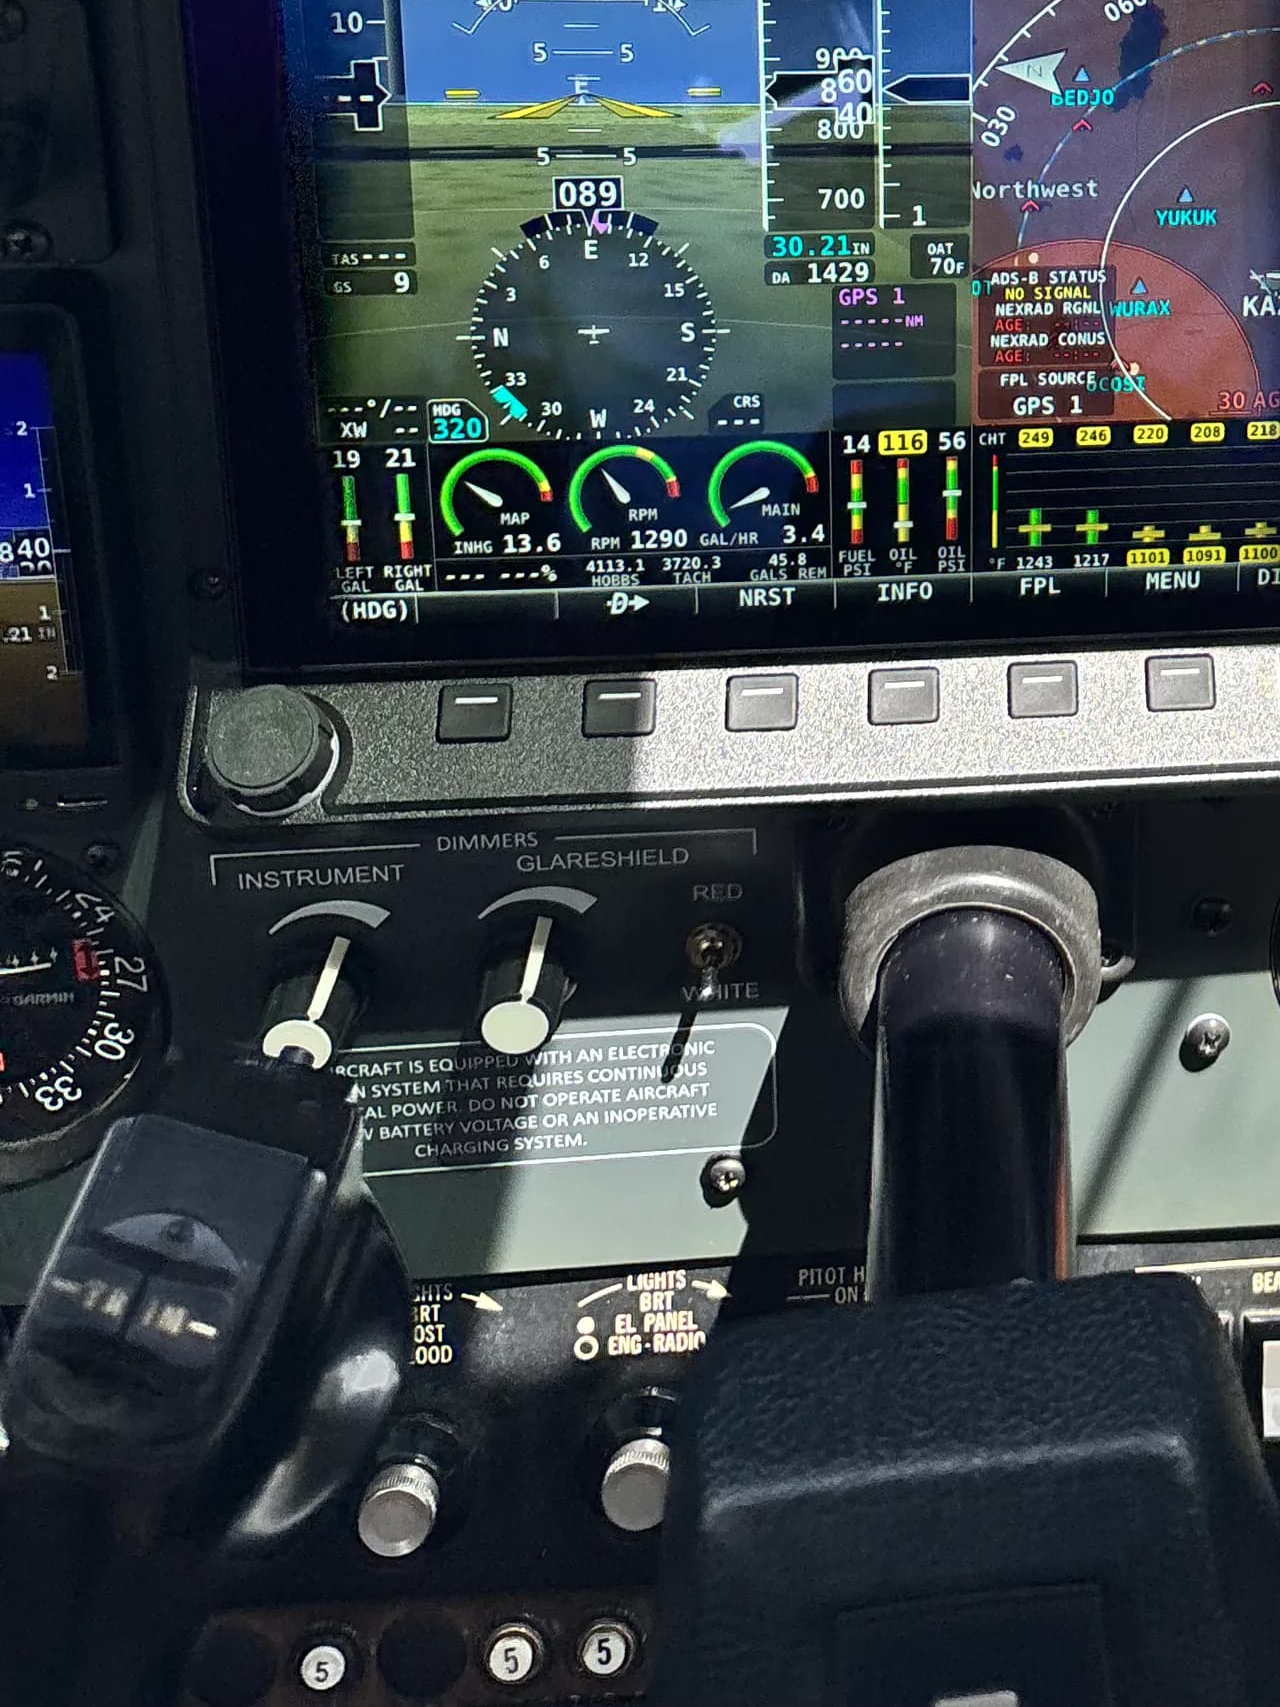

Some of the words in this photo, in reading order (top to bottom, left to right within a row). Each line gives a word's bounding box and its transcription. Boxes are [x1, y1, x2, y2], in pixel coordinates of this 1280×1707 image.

[331, 12, 364, 35] 10
[559, 182, 618, 207] 089
[818, 189, 865, 209] 700
[1156, 209, 1217, 225] YUKUK
[772, 235, 850, 257] 30.21
[927, 242, 953, 255] OAT
[772, 271, 790, 284] DA
[807, 262, 870, 283] 1429
[991, 271, 1039, 285] ADS-B
[1049, 269, 1106, 284] STATUS
[839, 289, 878, 306] GPS
[1005, 288, 1024, 301] NO
[1034, 286, 1091, 300] SIGNAL
[995, 302, 1054, 316] NEXRAD
[1063, 301, 1101, 315] RGNL
[990, 333, 1049, 347] NEXRAD
[1058, 332, 1106, 346] CONUS
[1000, 373, 1028, 386] FPL
[433, 404, 461, 417] HDG
[733, 395, 760, 408] CRS
[1013, 395, 1055, 414] GPS
[432, 419, 482, 439] 320
[979, 432, 1006, 445] CHT
[1022, 431, 1050, 445] 249
[843, 435, 871, 454] 14
[883, 434, 924, 451] 116
[938, 432, 966, 451] 56
[333, 450, 361, 469] 19
[385, 448, 416, 468] 21
[500, 512, 530, 525] MAP
[629, 508, 658, 521] RPM
[762, 503, 800, 516] MAIN
[454, 540, 493, 554] INHG
[503, 534, 561, 553] 13.6
[591, 537, 621, 550] RPM
[632, 529, 688, 549] 1290
[700, 532, 758, 546] GAL/HR
[783, 524, 825, 543] 3.4
[586, 558, 645, 573] 4113.1
[769, 553, 807, 566] 45.8
[839, 550, 876, 563] FUEL
[1016, 555, 1053, 569] 1243
[1073, 553, 1110, 567] 1217
[383, 564, 432, 578] RIGHT
[674, 571, 711, 585] TACH
[844, 563, 871, 576] PSI
[395, 579, 424, 591] GAL
[592, 573, 640, 587] HOBBS
[1020, 576, 1061, 595] FPL
[1146, 571, 1200, 590] MENU
[739, 587, 796, 607] NRST
[878, 582, 933, 602] INFO
[342, 600, 408, 622] (HDG)
[437, 832, 538, 852] DIMMERS
[516, 846, 690, 872] GLARESHIELD
[237, 863, 405, 890] INSTRUMENT
[693, 883, 743, 901] RED
[75, 892, 115, 923] 24
[115, 956, 148, 992] 27
[94, 1022, 134, 1061] 30
[409, 1060, 424, 1074] IS
[525, 1050, 572, 1069] WITH
[576, 1047, 603, 1063] AN
[608, 1040, 714, 1061] ELECTRONIC
[372, 1079, 440, 1098] SYSTEM
[445, 1076, 489, 1092] THAT
[497, 1069, 585, 1089] REQUIRES
[588, 1061, 707, 1082] CONTINUOUS
[36, 1076, 82, 1111] 33
[469, 1096, 495, 1112] DO
[501, 1093, 537, 1110] NOT
[543, 1089, 621, 1107] OPERATE
[626, 1082, 709, 1101] AIRCRAFT
[380, 1121, 453, 1140] BATTERY
[459, 1115, 539, 1134] VOLTAGE
[543, 1112, 566, 1128] OR
[573, 1110, 598, 1126] AN
[605, 1103, 717, 1123] INOPERATIVE
[415, 1139, 509, 1159] CHARGING
[514, 1131, 587, 1151] SYSTEM.
[627, 1269, 687, 1292] LIGHTS
[798, 1266, 847, 1286] PITOT
[639, 1291, 674, 1311] BRT
[615, 1313, 637, 1333] EL
[644, 1308, 698, 1332] PANEL
